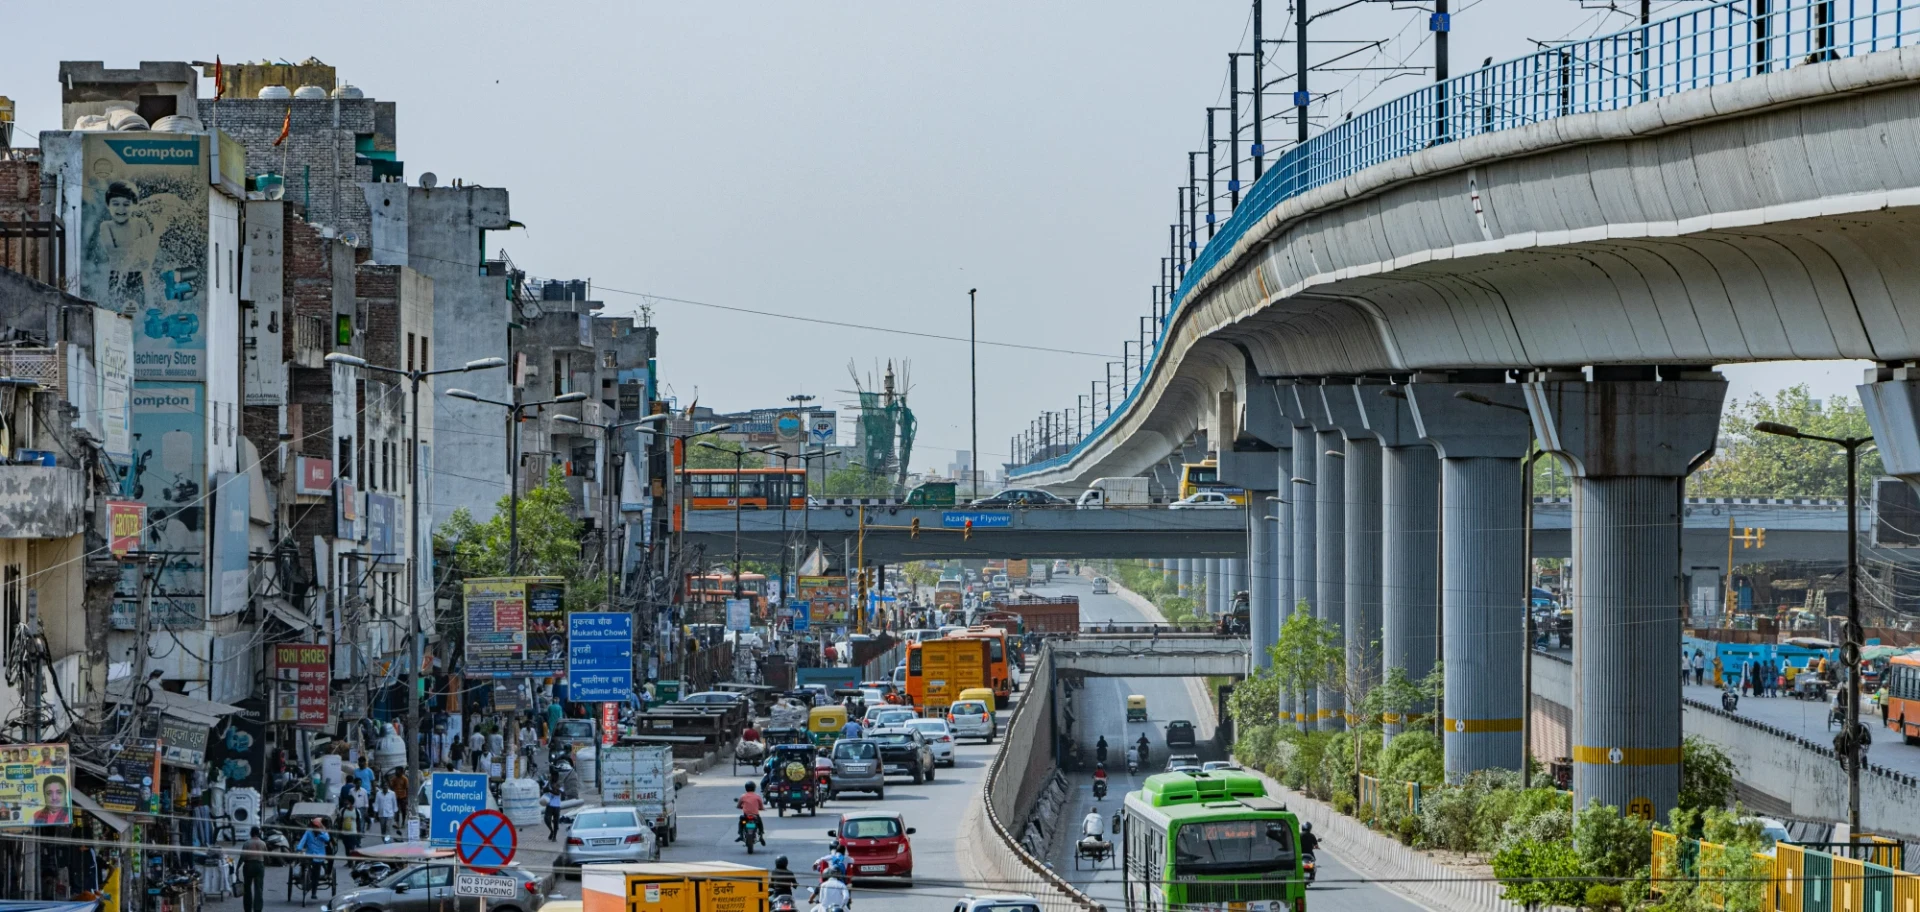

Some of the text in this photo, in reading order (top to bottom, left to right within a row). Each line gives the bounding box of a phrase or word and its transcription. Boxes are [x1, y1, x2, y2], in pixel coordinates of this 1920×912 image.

[122, 146, 194, 160] Crompton
[174, 351, 196, 364] Store
[134, 395, 189, 407] ompton
[742, 423, 773, 432] STORAGES
[980, 514, 1010, 523] Flyover
[114, 513, 139, 537] GROVER
[572, 617, 612, 628] मुकरबा चौक
[277, 649, 326, 664] TONI SHOES
[581, 675, 624, 684] शालीमार बाग
[581, 687, 631, 696] Shalimar Bagh
[237, 709, 260, 717] pton
[161, 727, 205, 747] आहुजा शूज
[443, 778, 477, 789] Azadpur
[435, 790, 483, 800] Commercial
[637, 791, 657, 800] PLEASE
[440, 802, 476, 814] Complex
[474, 877, 513, 887] STOPPING
[473, 886, 513, 896] STANDING
[660, 882, 735, 899] मदर डेयरी
